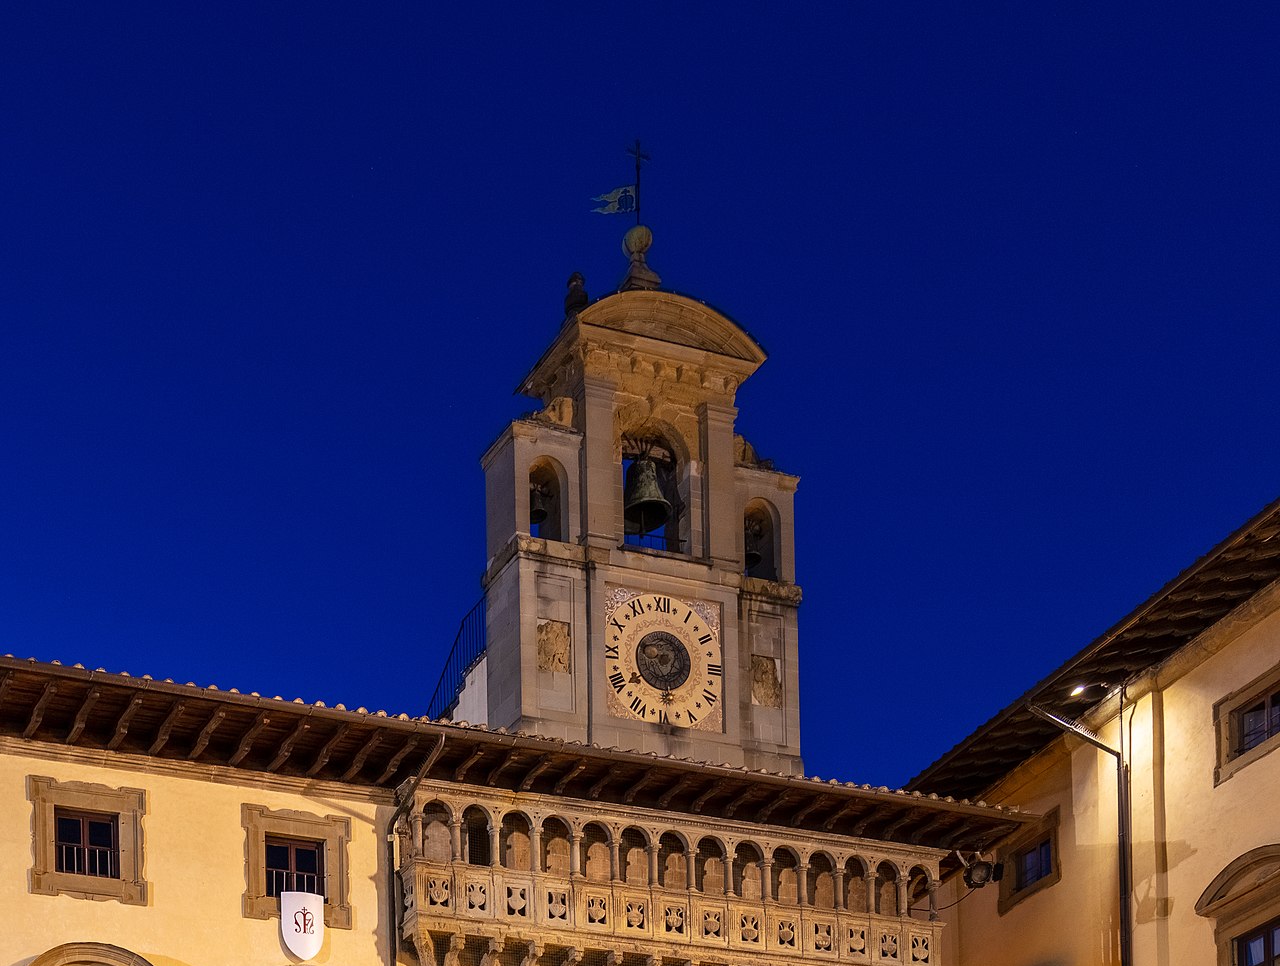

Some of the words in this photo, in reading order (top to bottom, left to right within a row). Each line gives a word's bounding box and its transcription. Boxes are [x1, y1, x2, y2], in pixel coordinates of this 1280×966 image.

[628, 599, 645, 617] XI
[654, 597, 670, 613] XII
[610, 618, 626, 633] X
[698, 634, 712, 645] II
[605, 645, 619, 659] IX
[708, 664, 721, 676] III
[609, 672, 626, 694] VIII
[630, 696, 647, 718] VII
